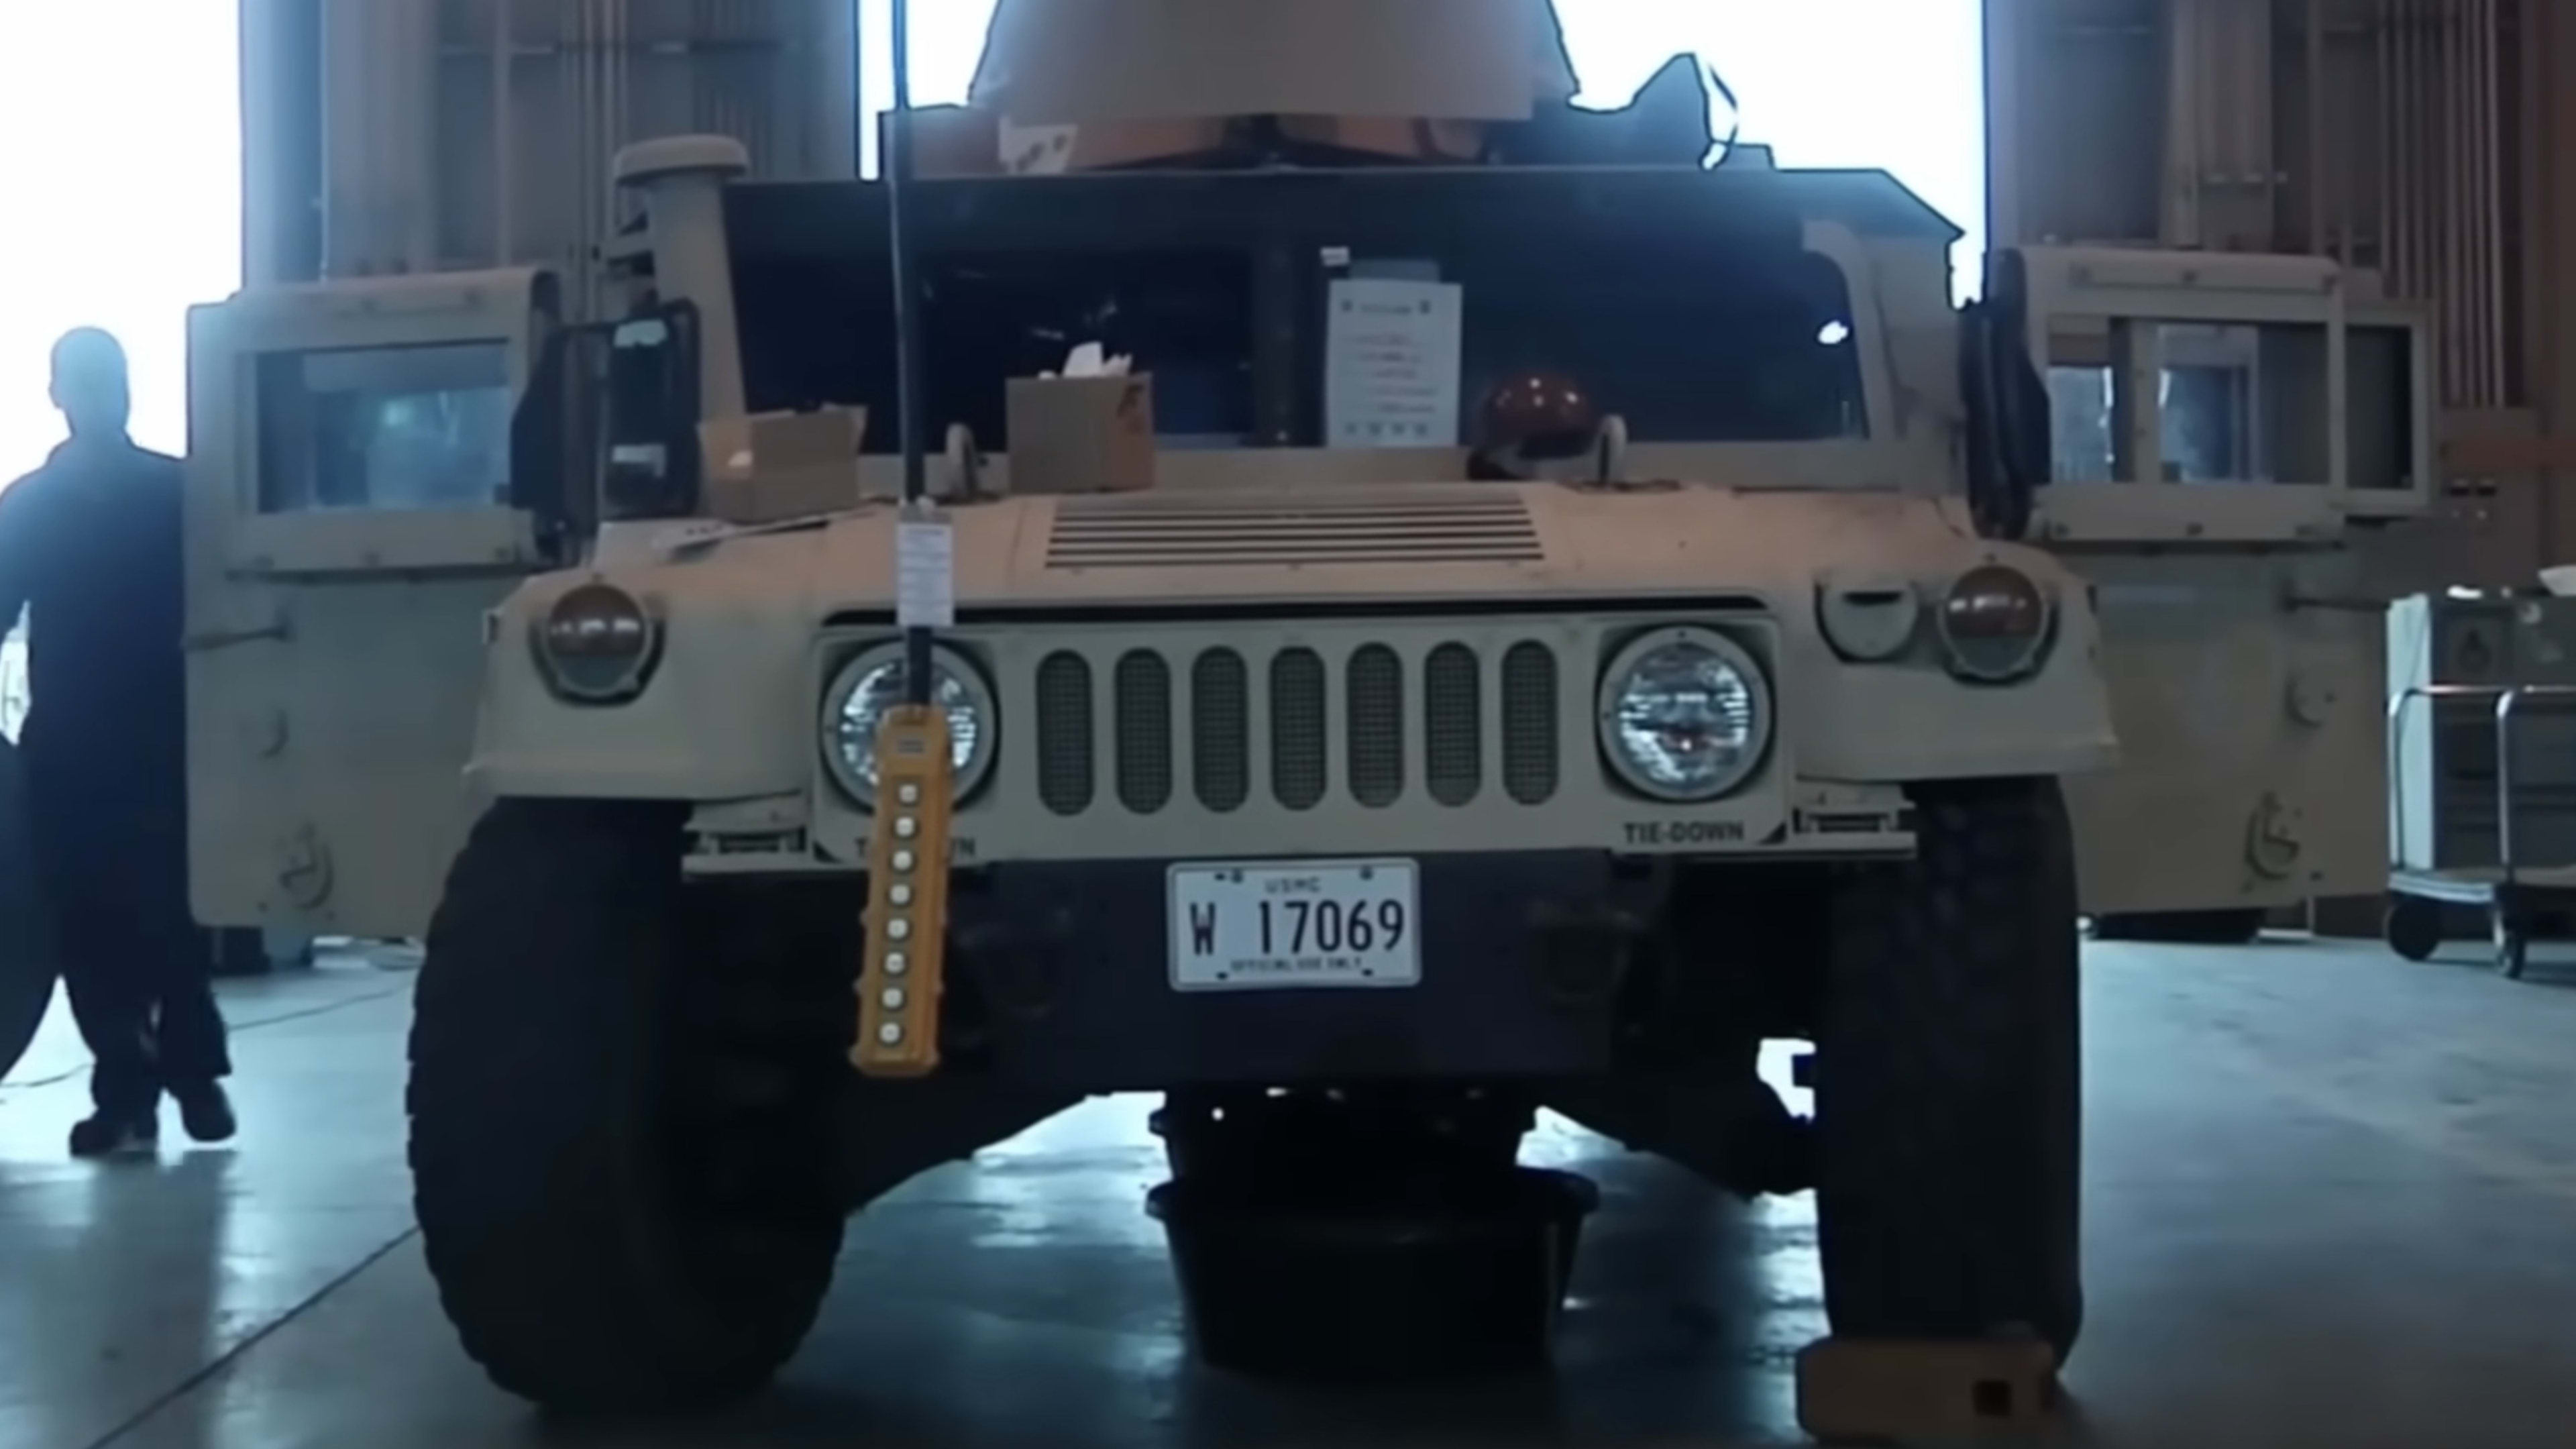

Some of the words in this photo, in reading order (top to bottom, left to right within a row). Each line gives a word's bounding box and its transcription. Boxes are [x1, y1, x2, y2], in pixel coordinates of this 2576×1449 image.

[1623, 820, 1743, 843] TIE-DOWN
[1265, 877, 1321, 894] USMC
[1189, 902, 1216, 955] W
[1259, 899, 1404, 954] 17069
